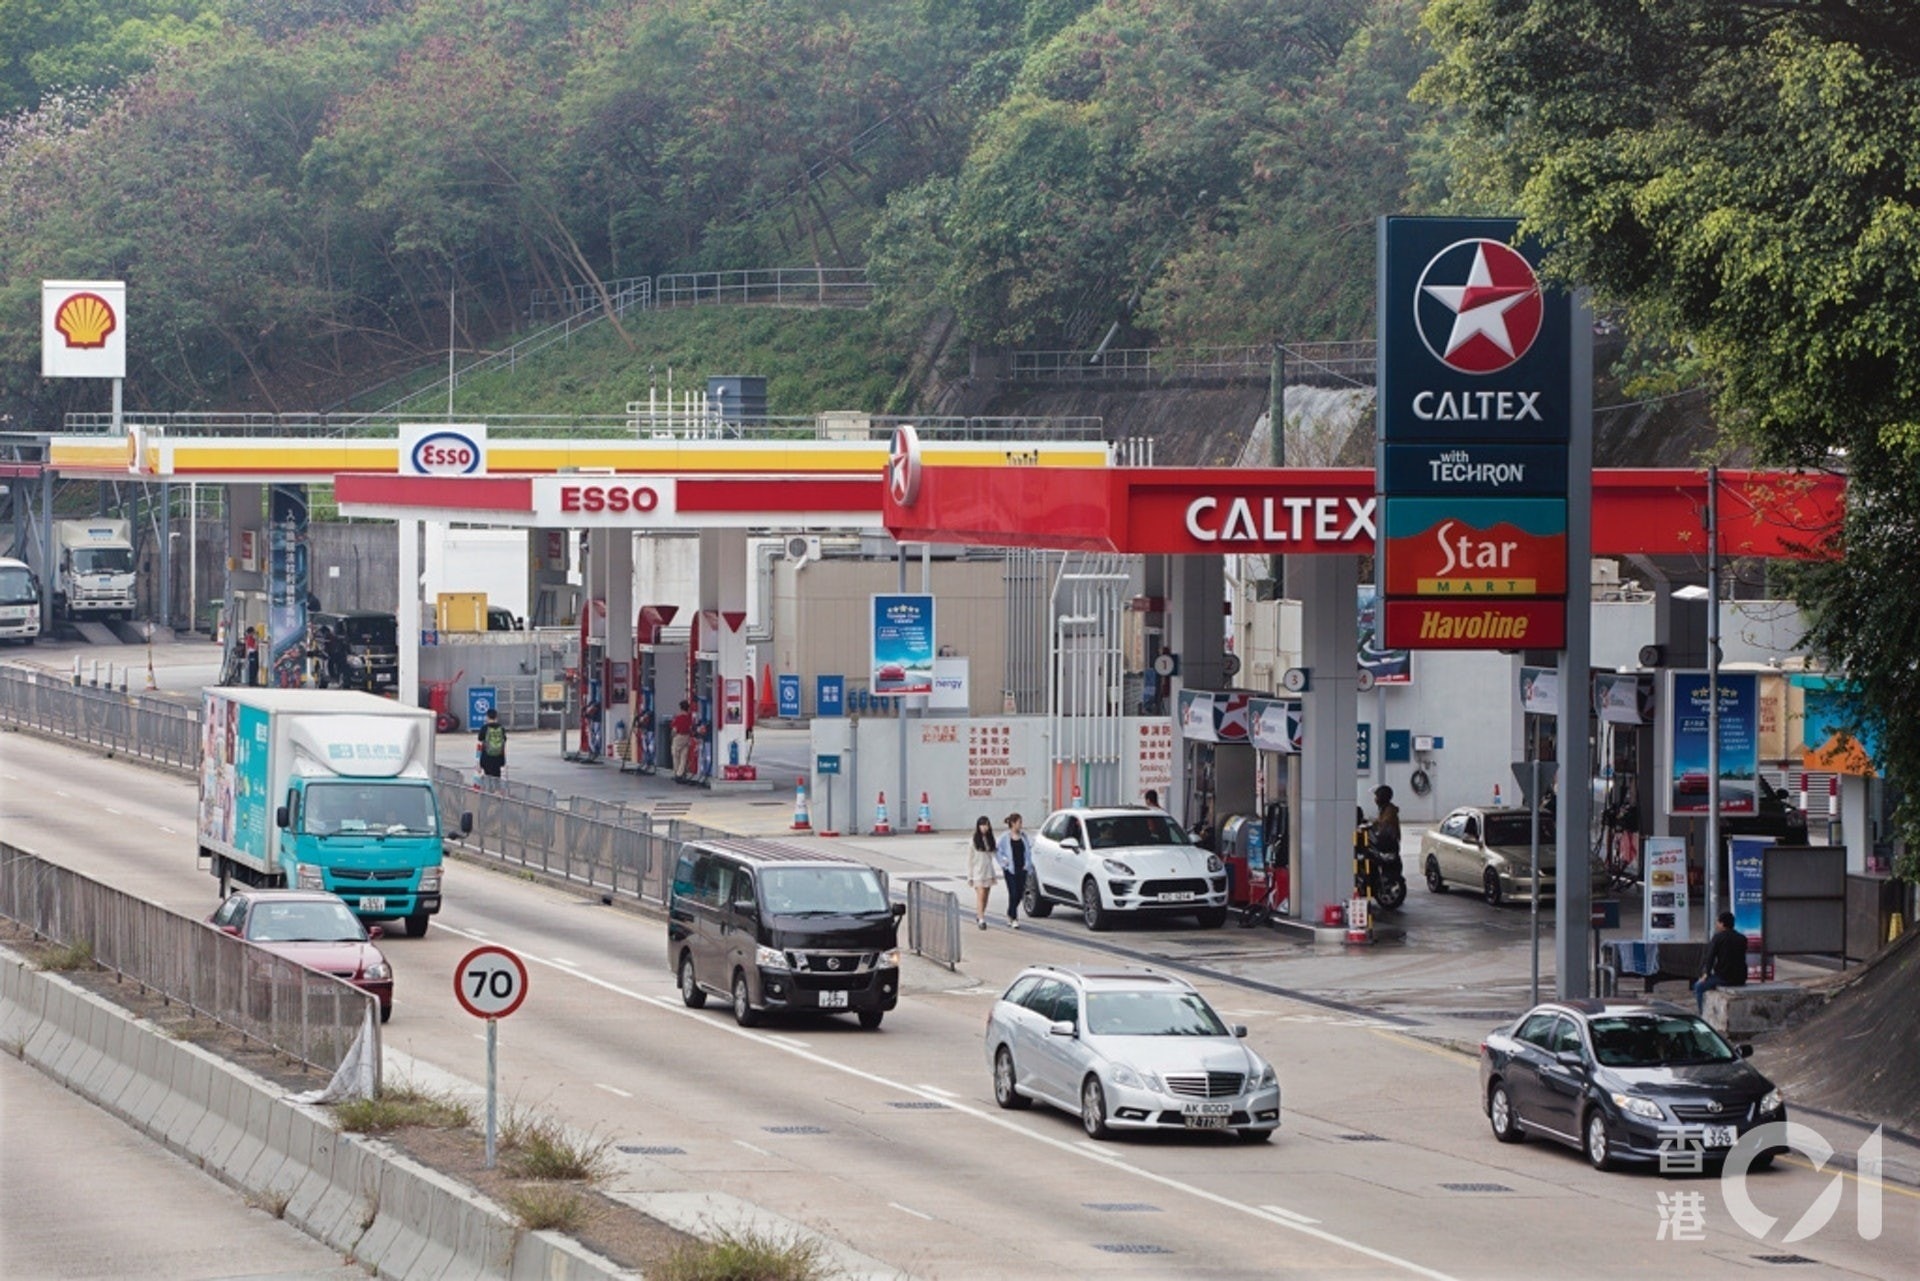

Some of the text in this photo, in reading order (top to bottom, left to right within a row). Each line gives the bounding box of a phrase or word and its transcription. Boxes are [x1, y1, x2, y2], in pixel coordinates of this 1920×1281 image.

[1412, 391, 1543, 421] CALTEX
[423, 445, 470, 465] Esso
[1441, 450, 1469, 463] with
[1429, 460, 1524, 486] TECHRON
[561, 487, 659, 512] ESSO
[1185, 497, 1375, 541] CALTEX
[1436, 522, 1518, 577] Star
[1437, 581, 1517, 593] MART
[1420, 611, 1528, 639] Havoline
[935, 680, 962, 689] nergy
[980, 758, 1010, 766] SMOKING
[1003, 767, 1026, 776] LIGHTS
[969, 778, 1008, 787] SWITCH OFF
[468, 970, 513, 998] 70
[1184, 1103, 1199, 1113] AK
